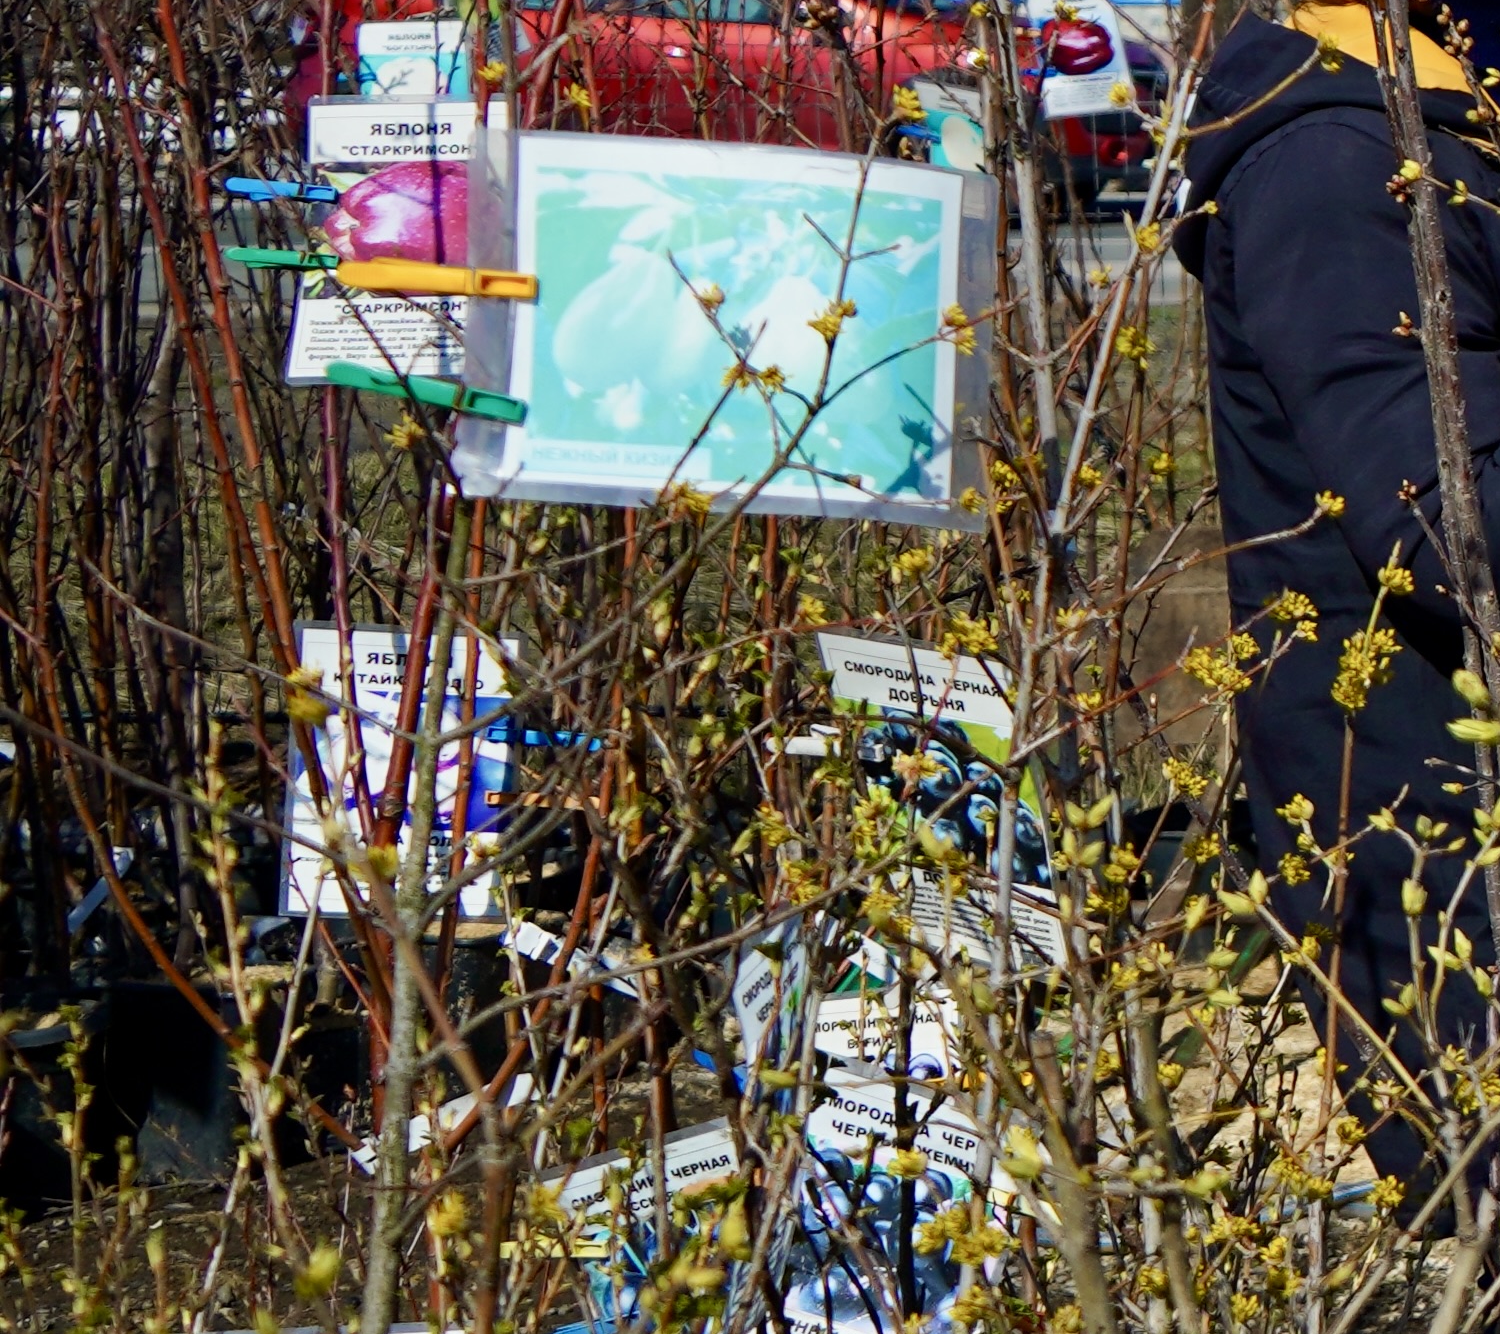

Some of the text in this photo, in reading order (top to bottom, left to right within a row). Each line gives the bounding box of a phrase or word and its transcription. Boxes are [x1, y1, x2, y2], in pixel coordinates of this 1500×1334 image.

[370, 123, 452, 136] ЯБЛОНЯ
[531, 444, 618, 465] НЕЖНЫЙ
[844, 660, 935, 686] СМОРОДИНА
[942, 1131, 977, 1152] ЧЕР
[671, 1154, 731, 1179] ЧЕРНАЯ
